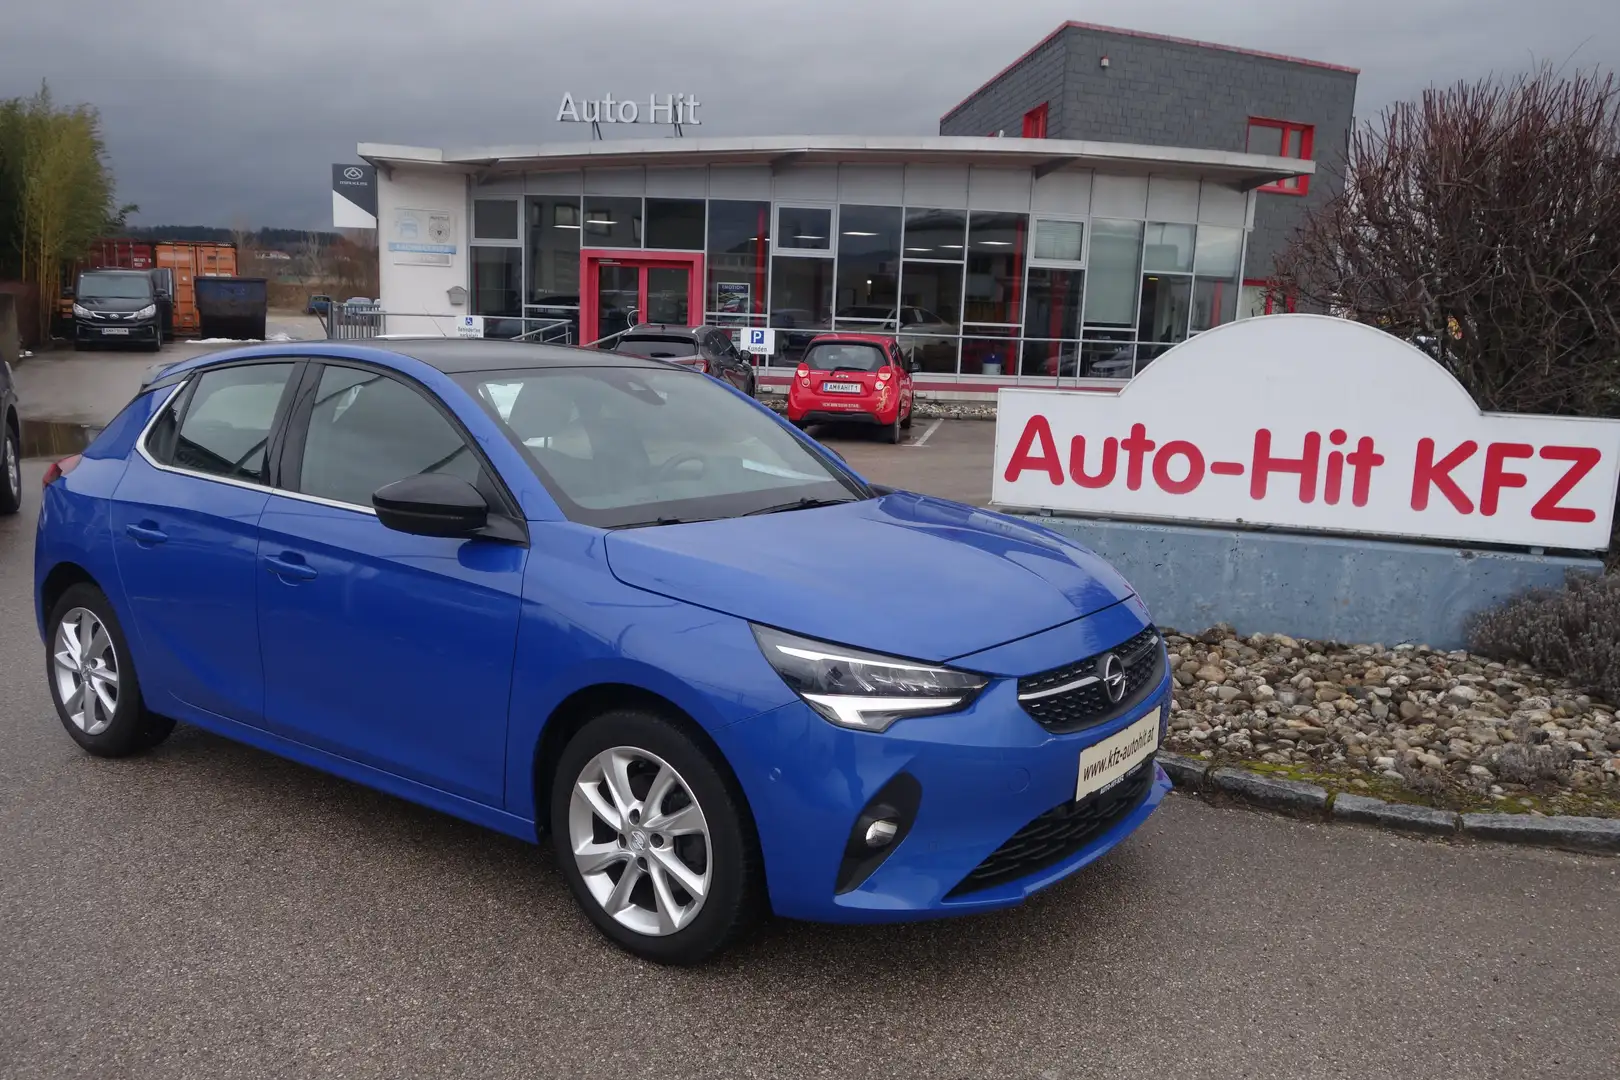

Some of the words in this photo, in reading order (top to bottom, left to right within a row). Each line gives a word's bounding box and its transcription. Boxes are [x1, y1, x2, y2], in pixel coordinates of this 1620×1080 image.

[556, 91, 638, 123] Auto
[649, 92, 701, 124] Hit
[747, 345, 768, 353] Kunden
[753, 331, 762, 343] P
[1004, 414, 1385, 508] Auto-Hit
[1410, 437, 1602, 524] KFZ
[1083, 725, 1155, 783] www.kfz-autohit.at
